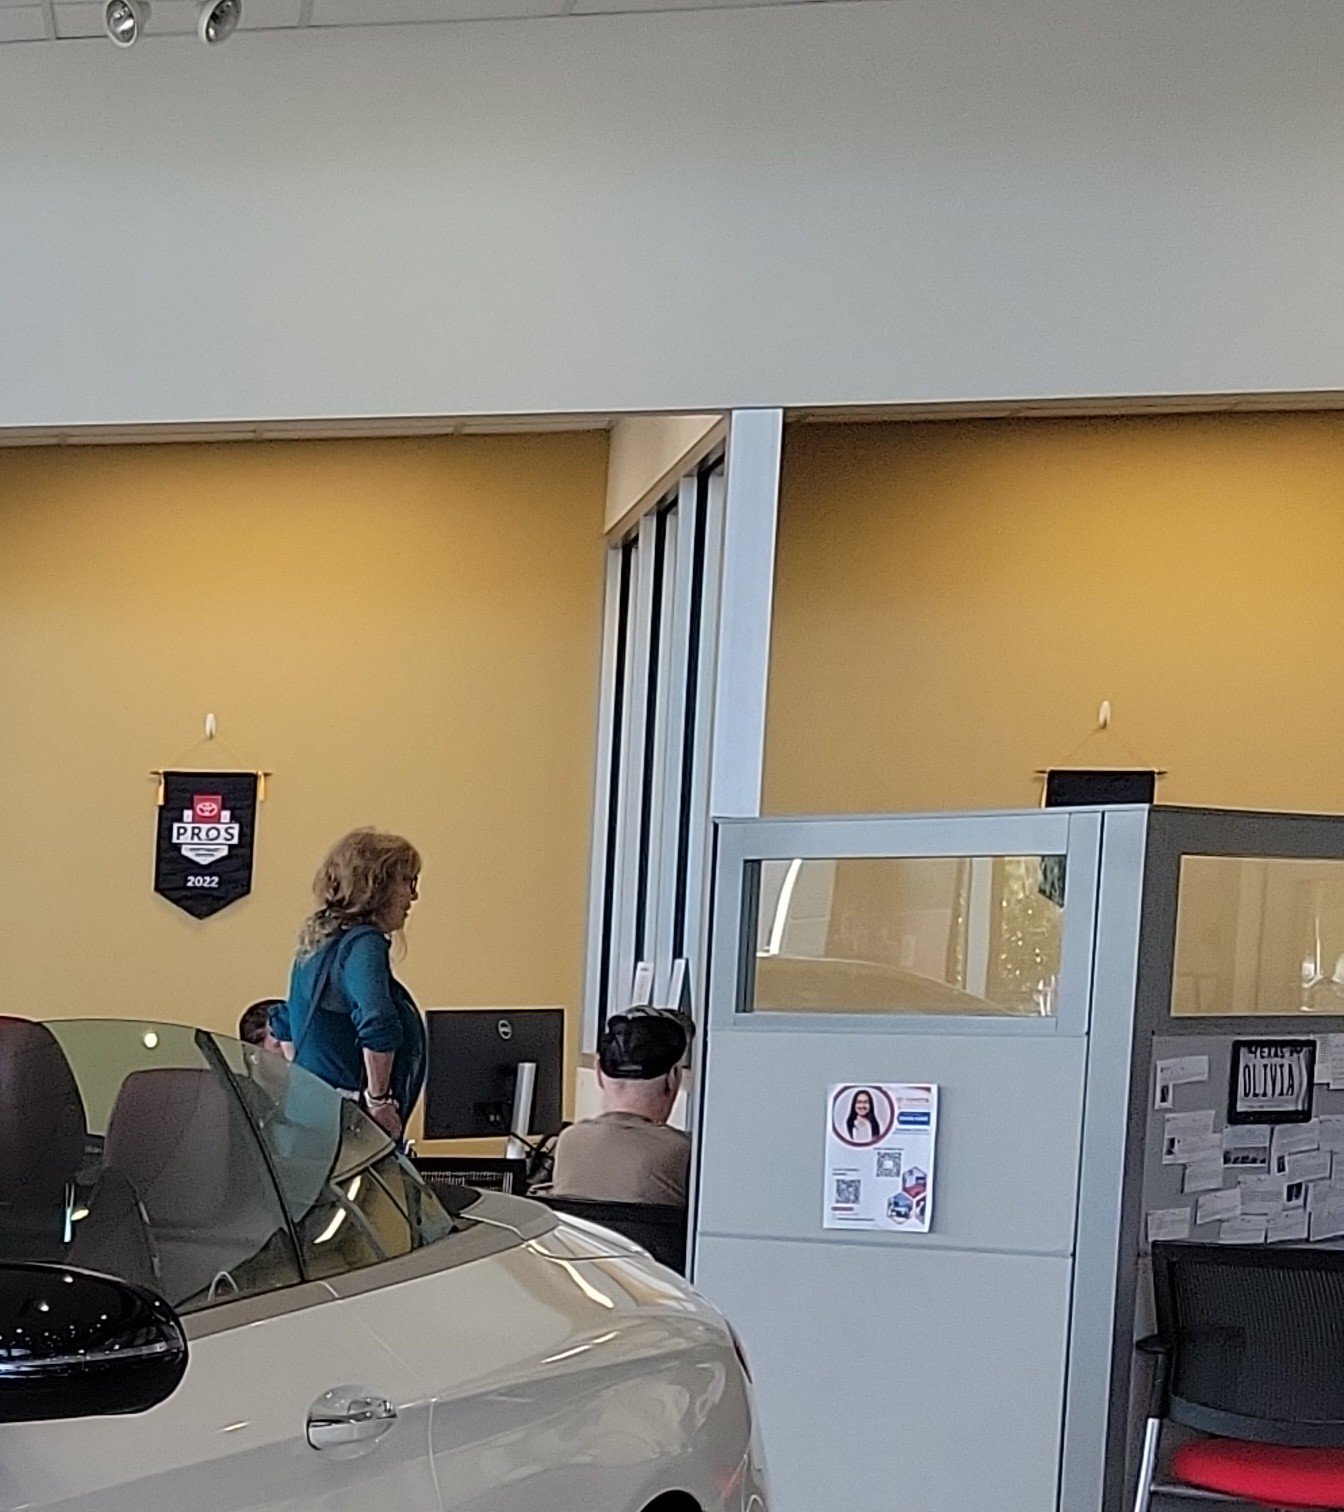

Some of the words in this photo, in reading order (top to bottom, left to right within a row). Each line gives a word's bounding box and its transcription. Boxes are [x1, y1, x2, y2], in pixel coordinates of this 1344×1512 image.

[175, 826, 236, 841] PROS
[186, 875, 220, 888] 2022
[1243, 1063, 1295, 1098] OLIVIA
